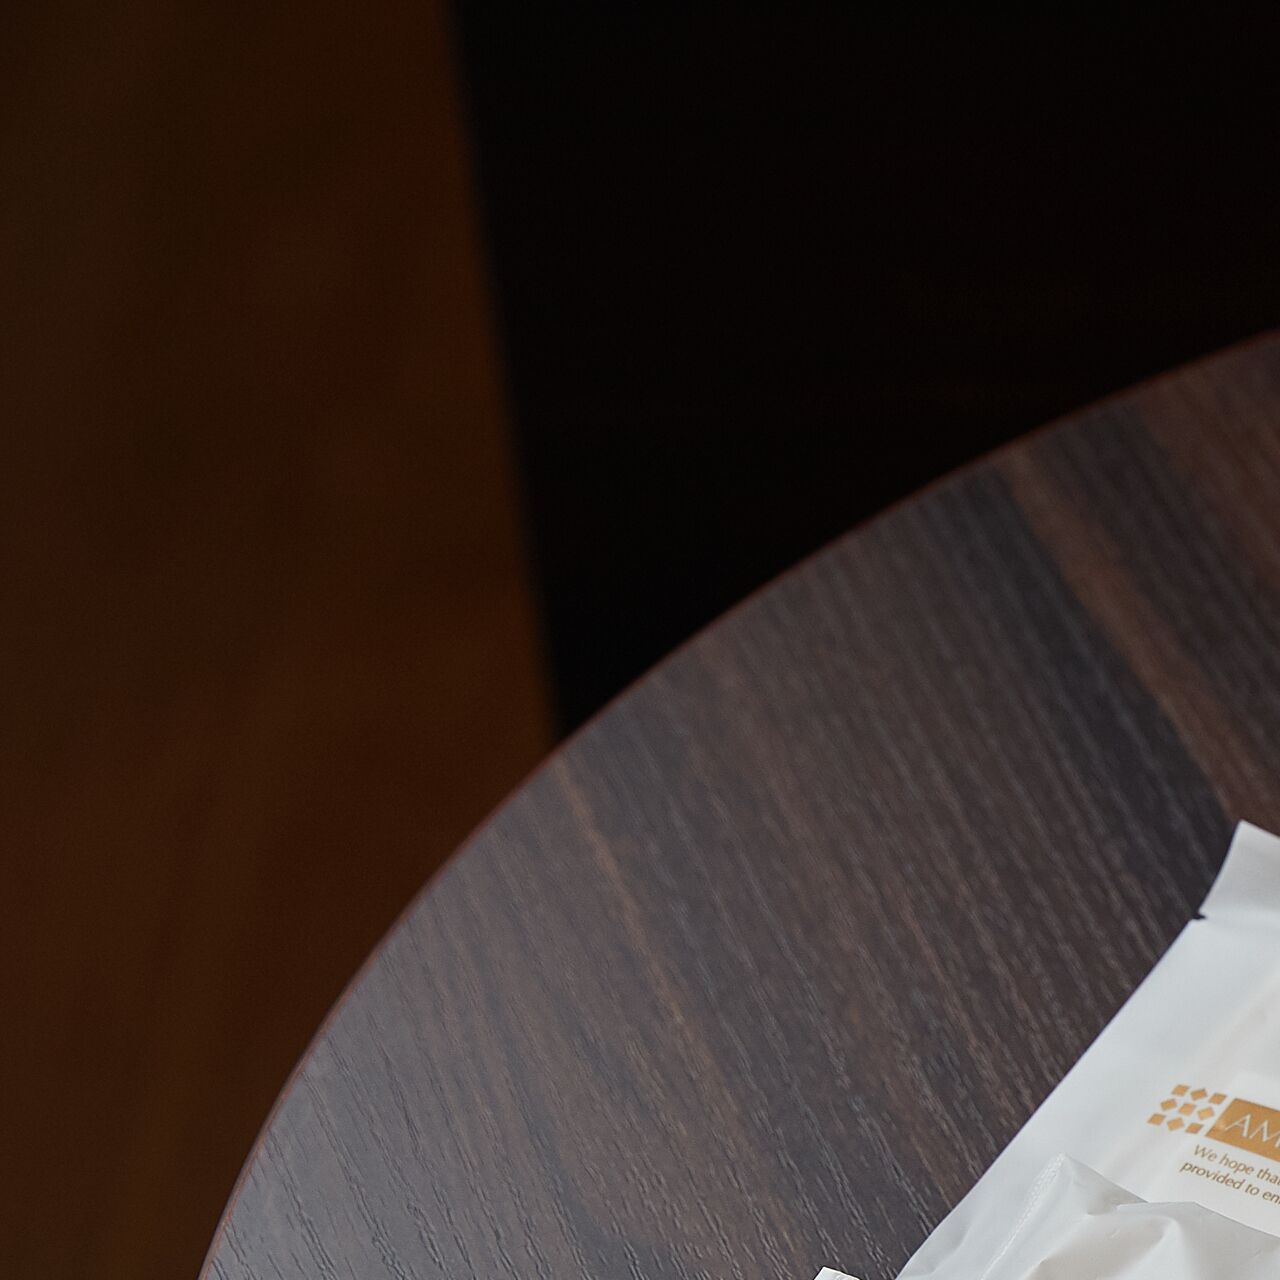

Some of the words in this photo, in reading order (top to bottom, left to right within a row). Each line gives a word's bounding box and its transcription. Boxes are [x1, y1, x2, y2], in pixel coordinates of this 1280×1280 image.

[1193, 1144, 1217, 1162] We
[1219, 1153, 1255, 1175] hope
[1179, 1160, 1246, 1190] provided
[1245, 1183, 1260, 1196] to
